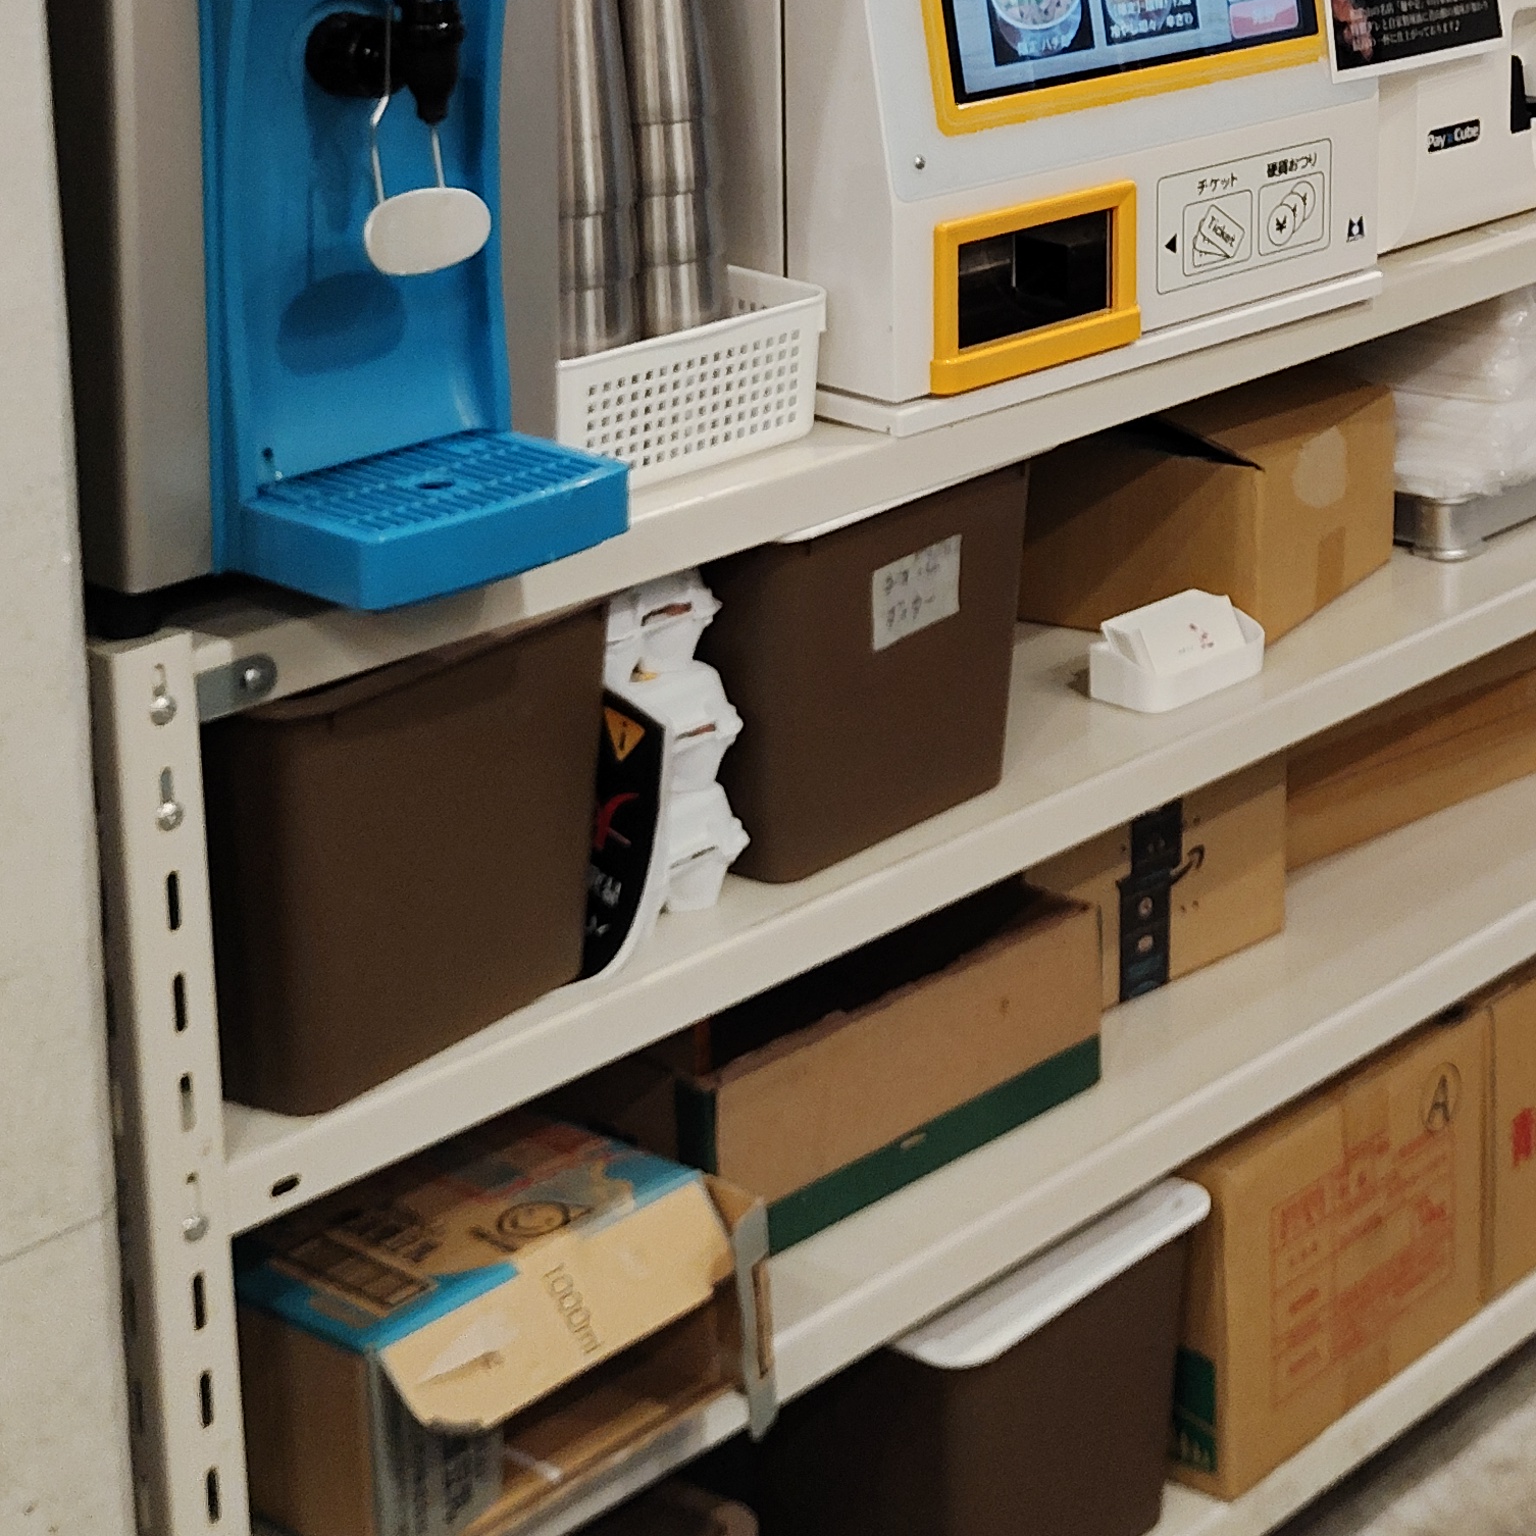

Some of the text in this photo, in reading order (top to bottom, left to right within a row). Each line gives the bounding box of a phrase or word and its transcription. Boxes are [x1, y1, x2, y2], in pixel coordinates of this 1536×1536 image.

[1427, 124, 1479, 149] Pay Cube
[1197, 173, 1238, 195] チケット
[1207, 215, 1236, 249] Ticket
